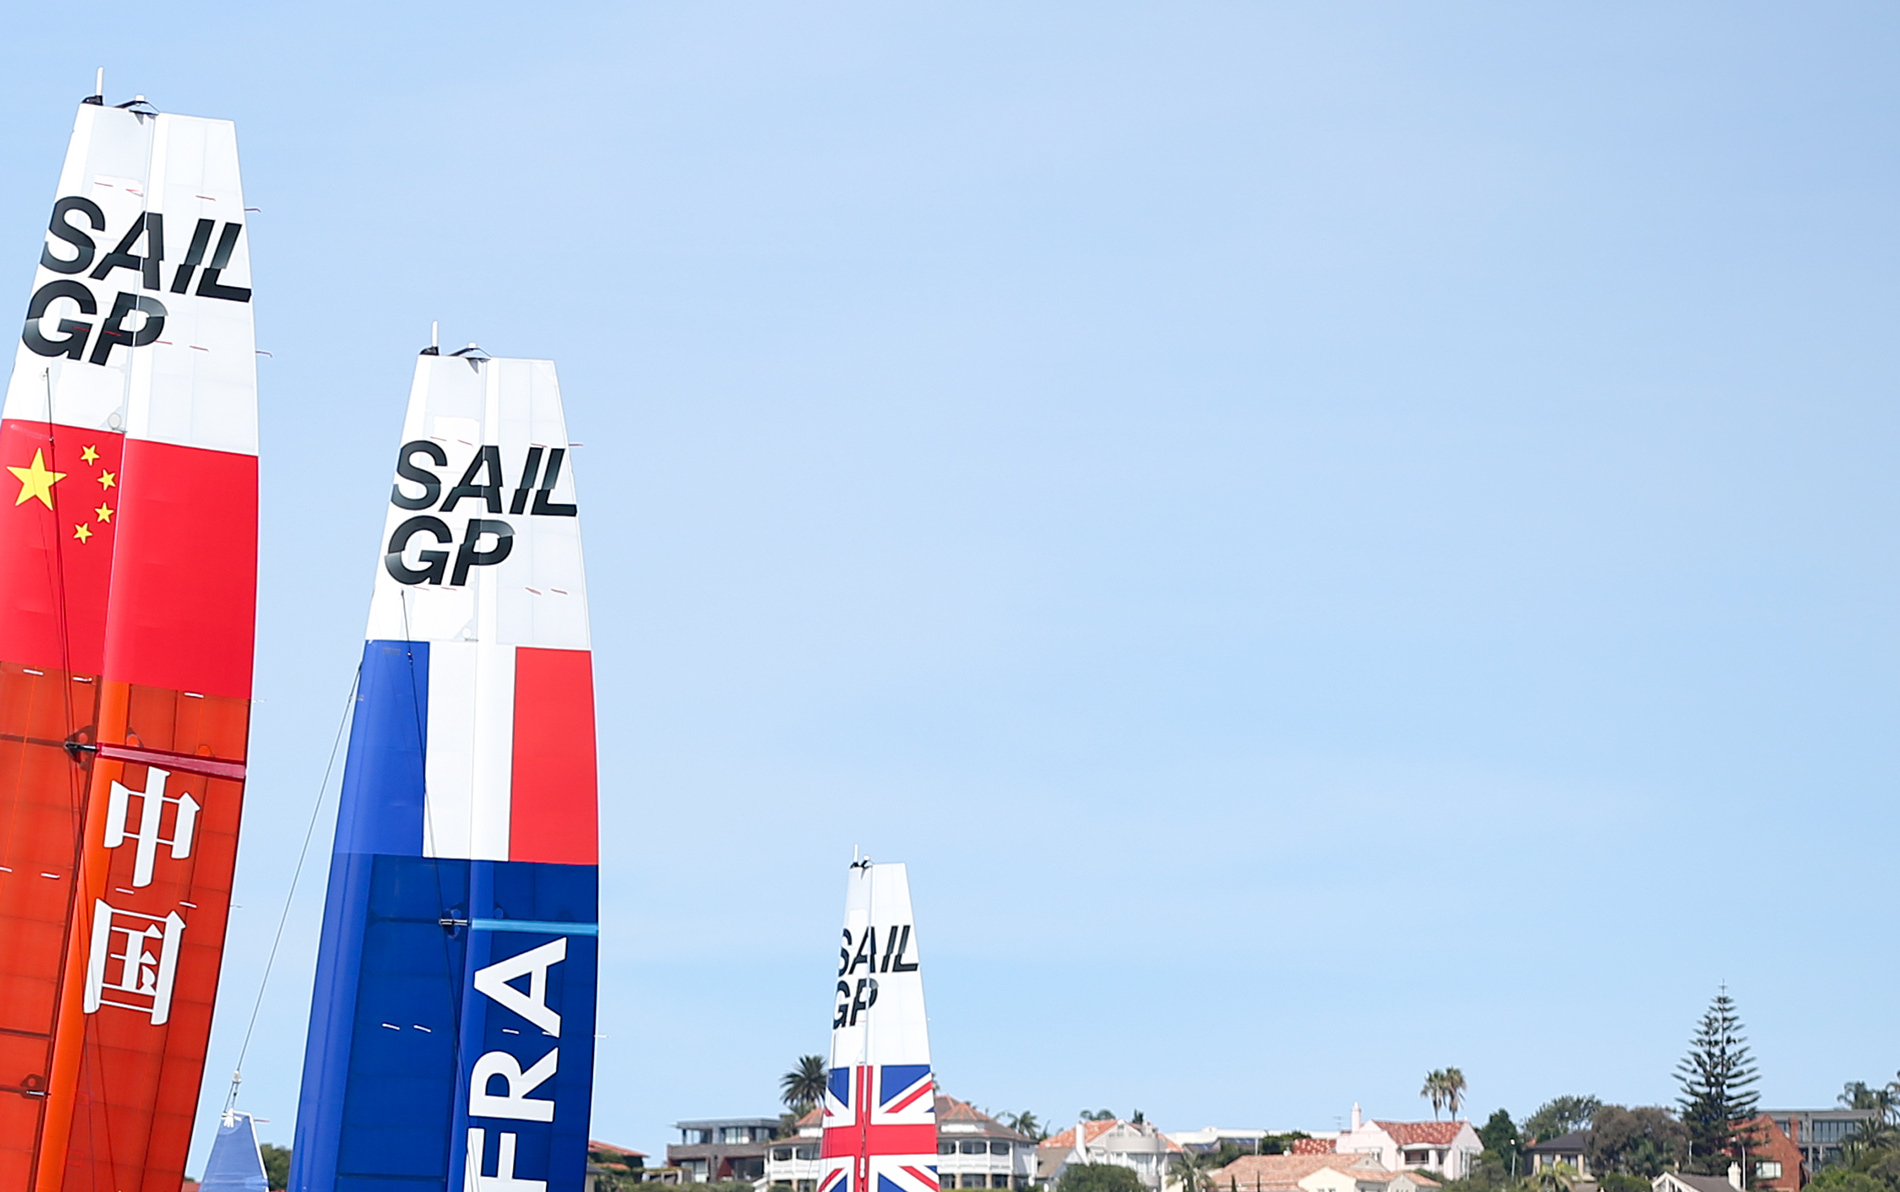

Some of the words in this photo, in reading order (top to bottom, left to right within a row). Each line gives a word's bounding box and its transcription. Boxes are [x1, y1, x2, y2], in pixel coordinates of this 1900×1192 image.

[40, 196, 252, 303] SAIL
[22, 279, 169, 367] GP
[391, 440, 579, 517] SAIL
[383, 514, 516, 587] GP
[83, 766, 200, 1026] 中国
[836, 925, 919, 974] SAIL
[832, 978, 879, 1031] GP
